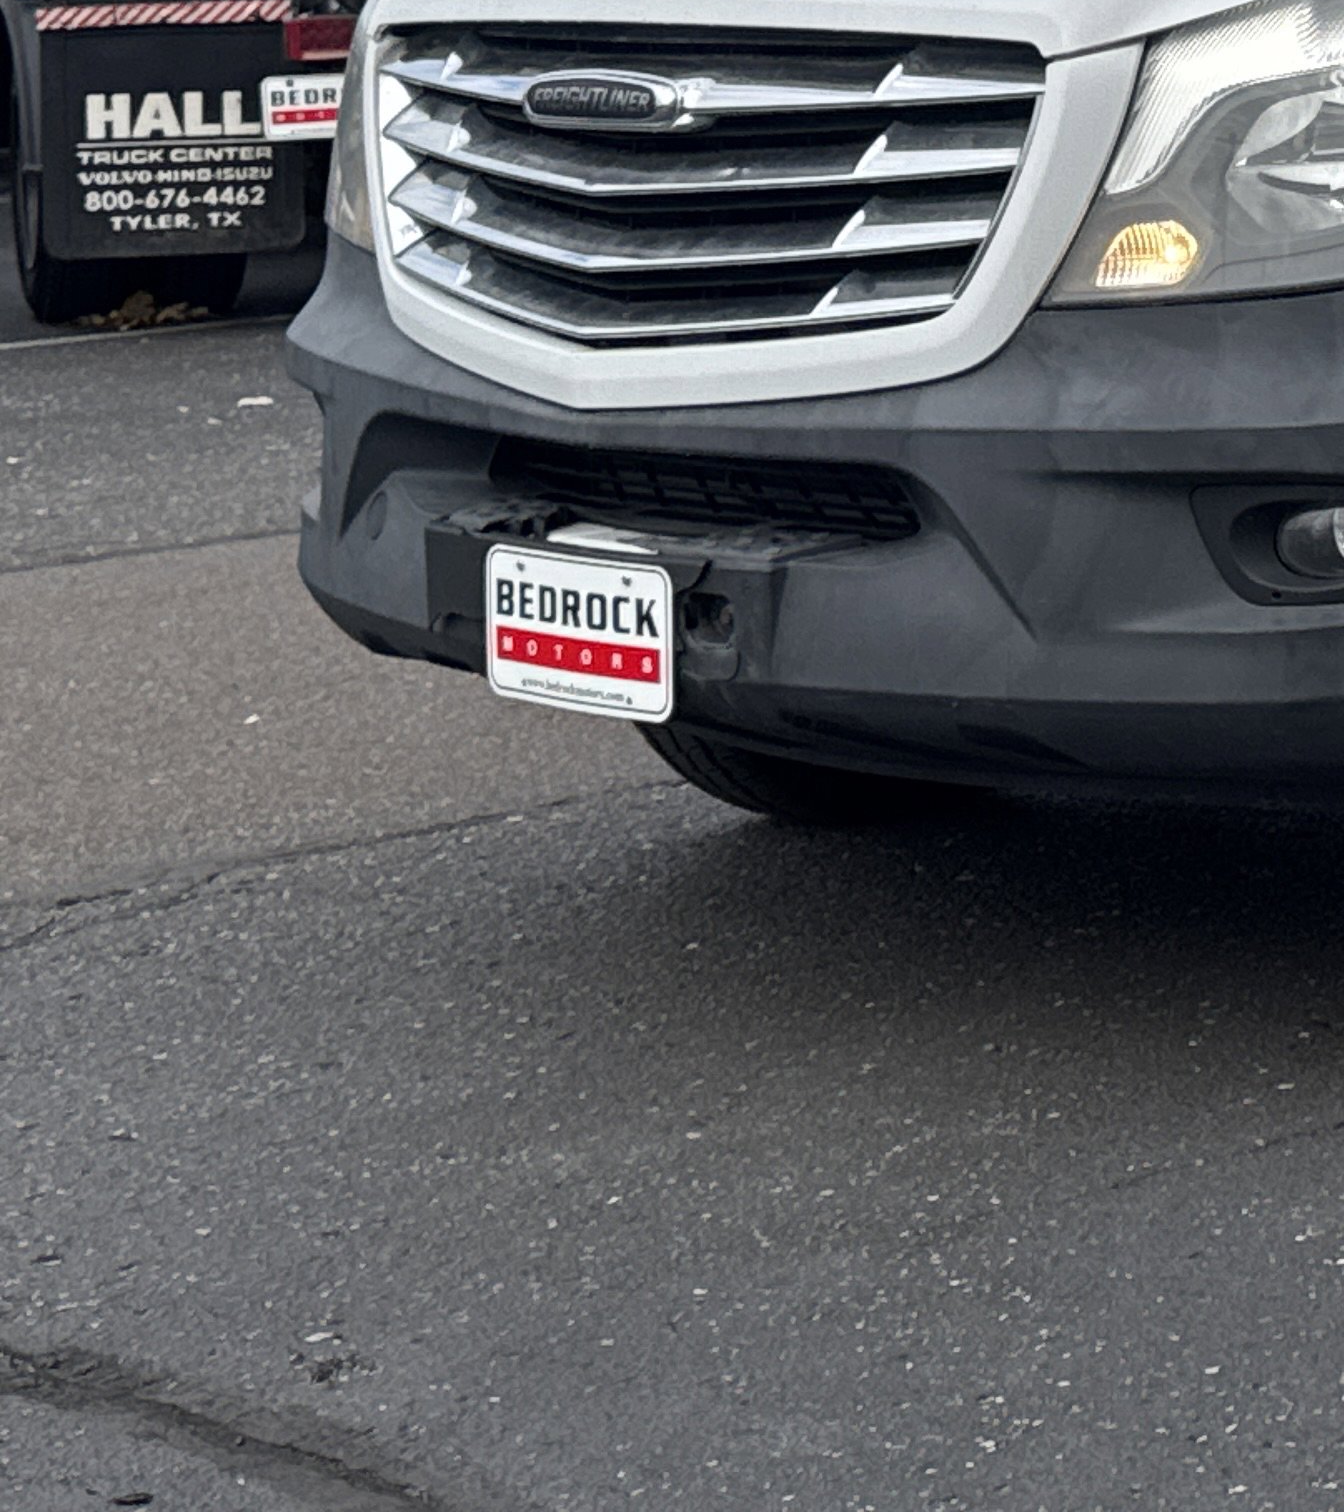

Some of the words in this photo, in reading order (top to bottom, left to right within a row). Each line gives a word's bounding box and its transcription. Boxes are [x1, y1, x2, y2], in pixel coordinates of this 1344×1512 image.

[271, 87, 337, 107] BEDR
[534, 85, 650, 111] FREIGHTLINER
[85, 90, 262, 139] HALL
[77, 148, 165, 165] TRUCK
[169, 145, 272, 162] CENTER
[84, 185, 266, 212] 800-676-4462
[110, 213, 199, 232] TYLER,
[207, 211, 242, 227] TX
[496, 577, 660, 638] BEDROCK
[502, 635, 654, 674] MOTORS
